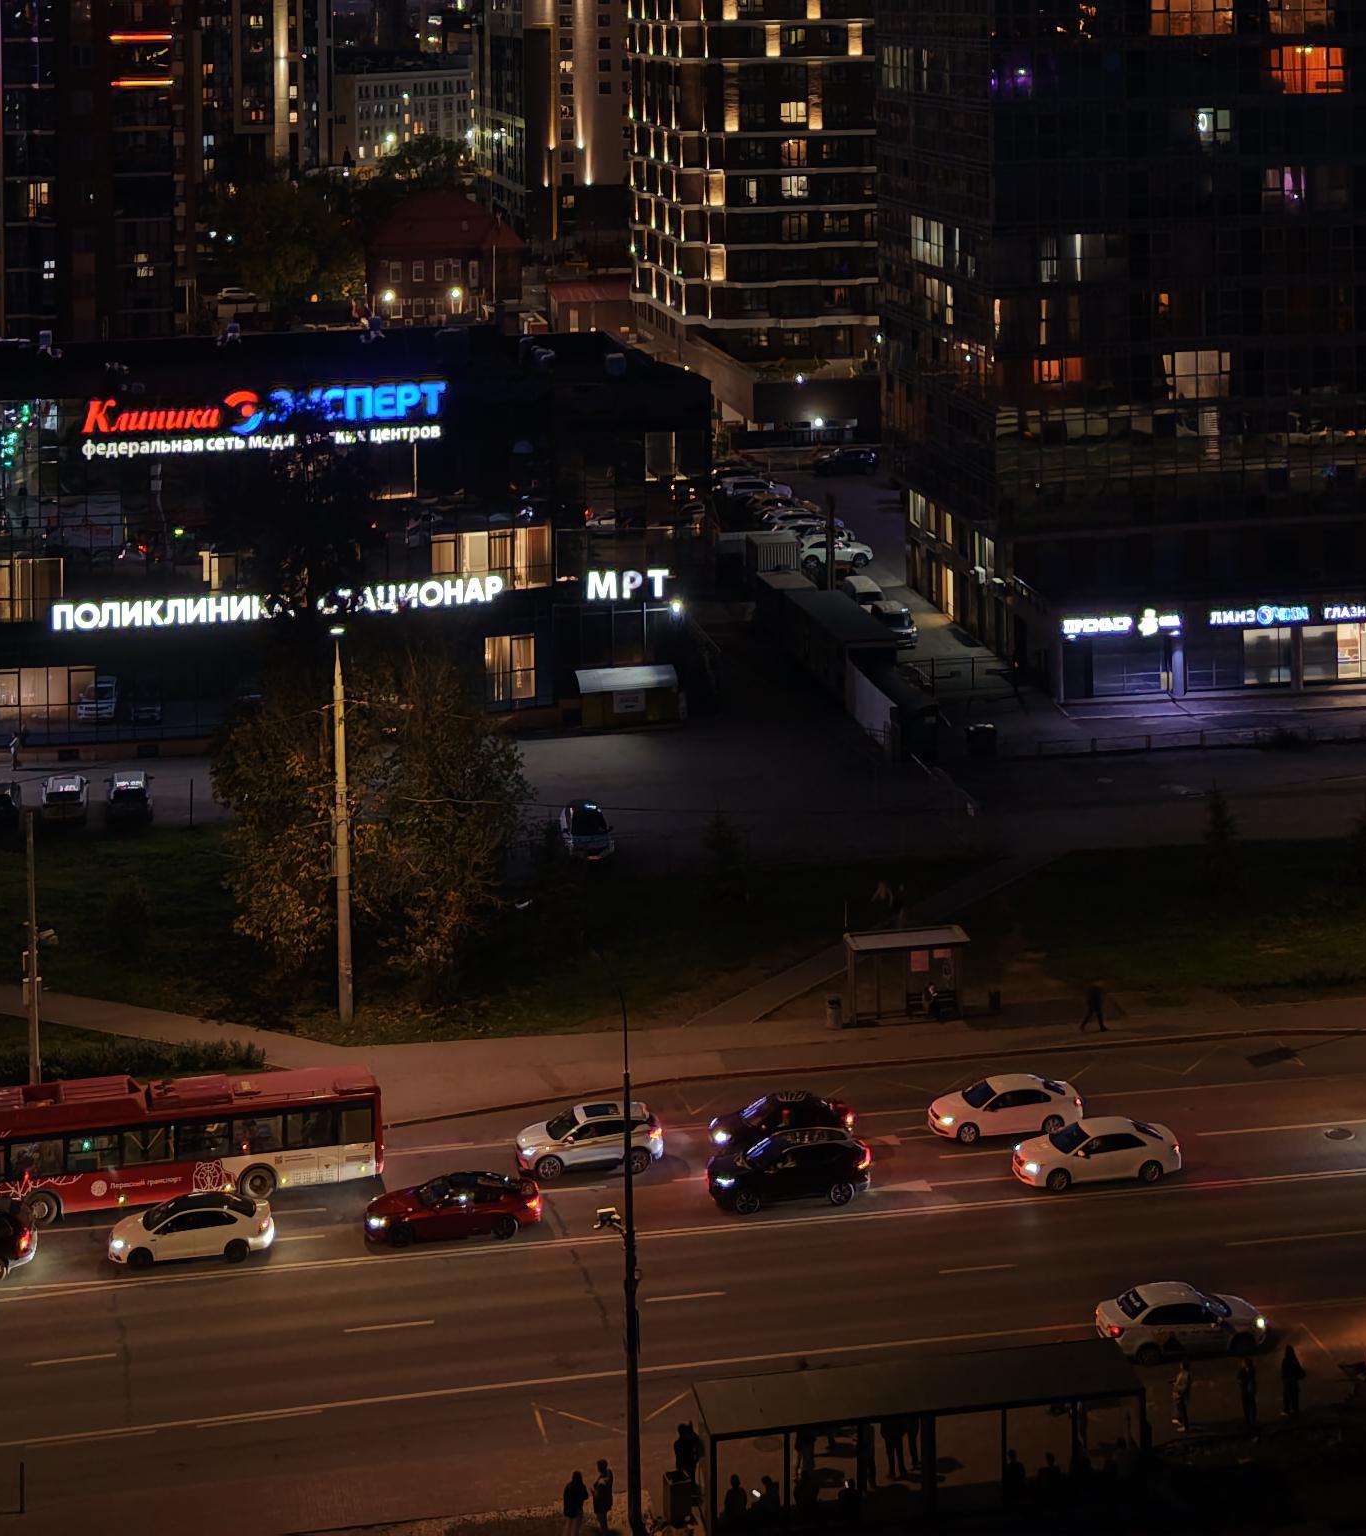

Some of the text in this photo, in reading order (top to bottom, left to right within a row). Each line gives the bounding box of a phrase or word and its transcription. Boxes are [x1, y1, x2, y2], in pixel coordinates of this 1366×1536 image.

[82, 399, 220, 433] Клиника
[82, 439, 204, 460] федеральная
[206, 436, 245, 451] сеть
[370, 425, 441, 444] центров
[587, 569, 669, 600] МРТ
